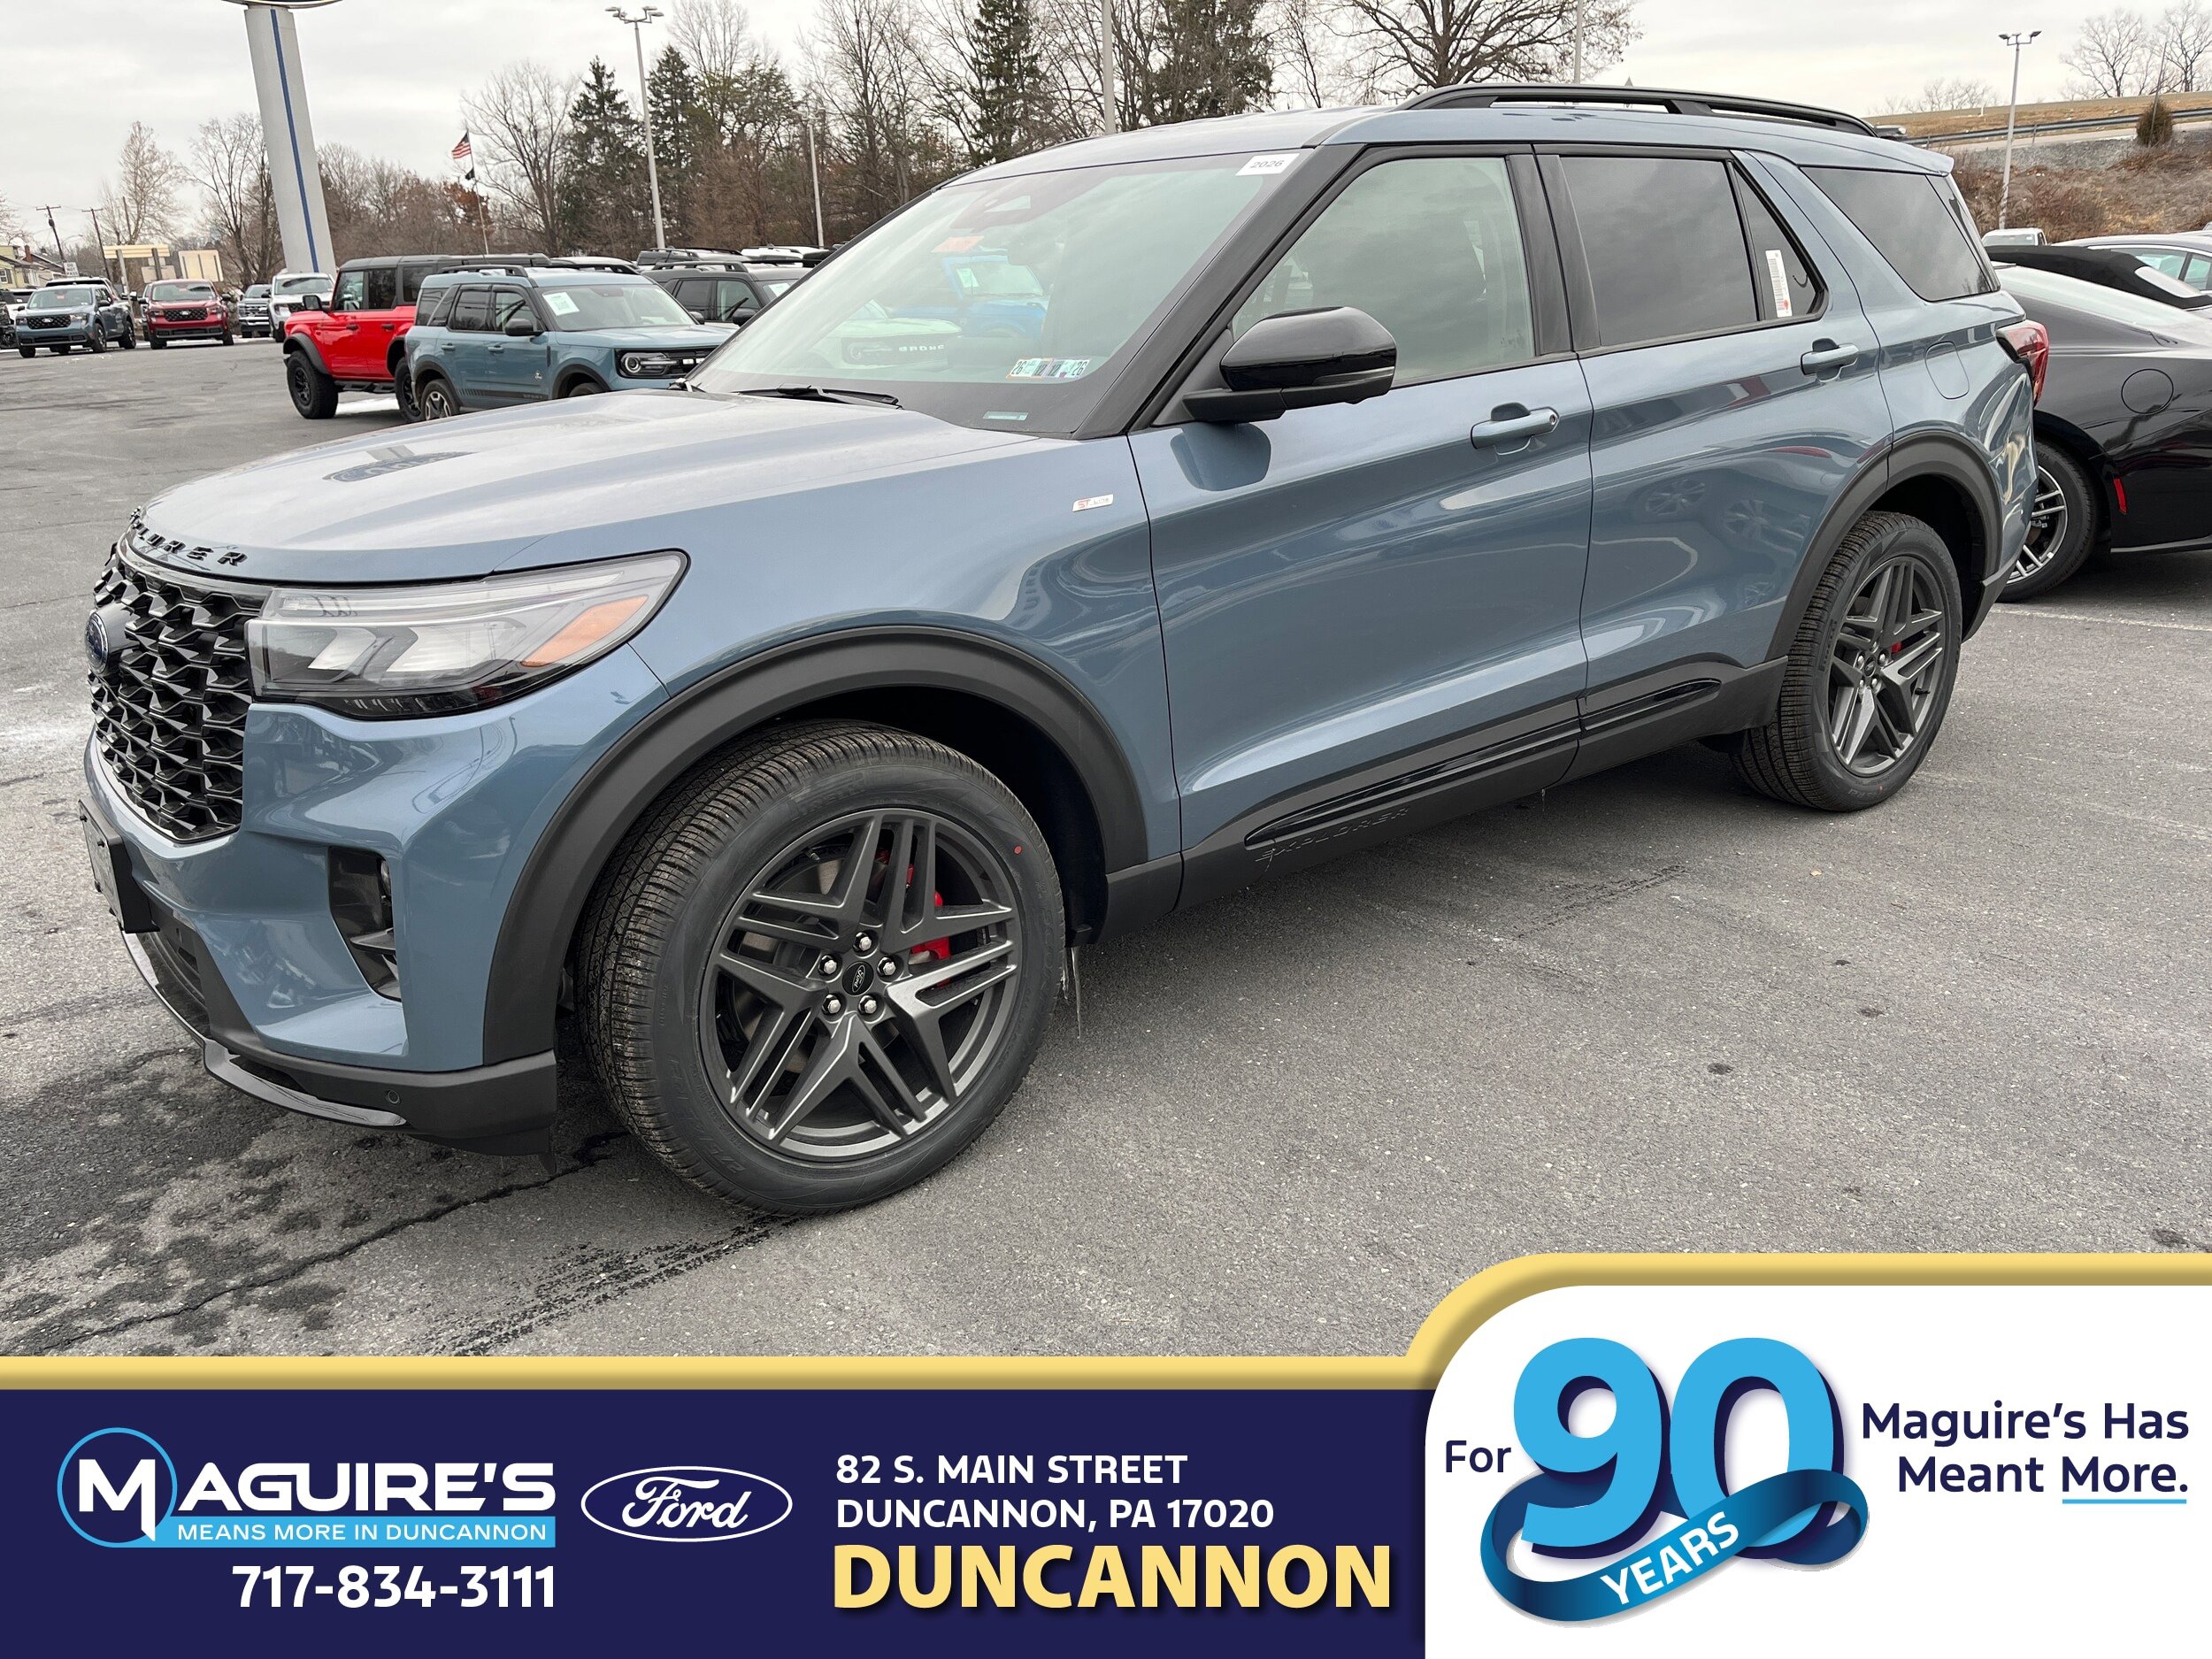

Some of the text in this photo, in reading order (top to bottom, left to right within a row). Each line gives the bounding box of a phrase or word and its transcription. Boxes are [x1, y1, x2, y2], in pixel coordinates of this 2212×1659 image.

[1249, 159, 1285, 169] 2026
[1011, 360, 1027, 375] 26
[1071, 361, 1087, 376] 26
[1255, 806, 1409, 864] EXPLORER
